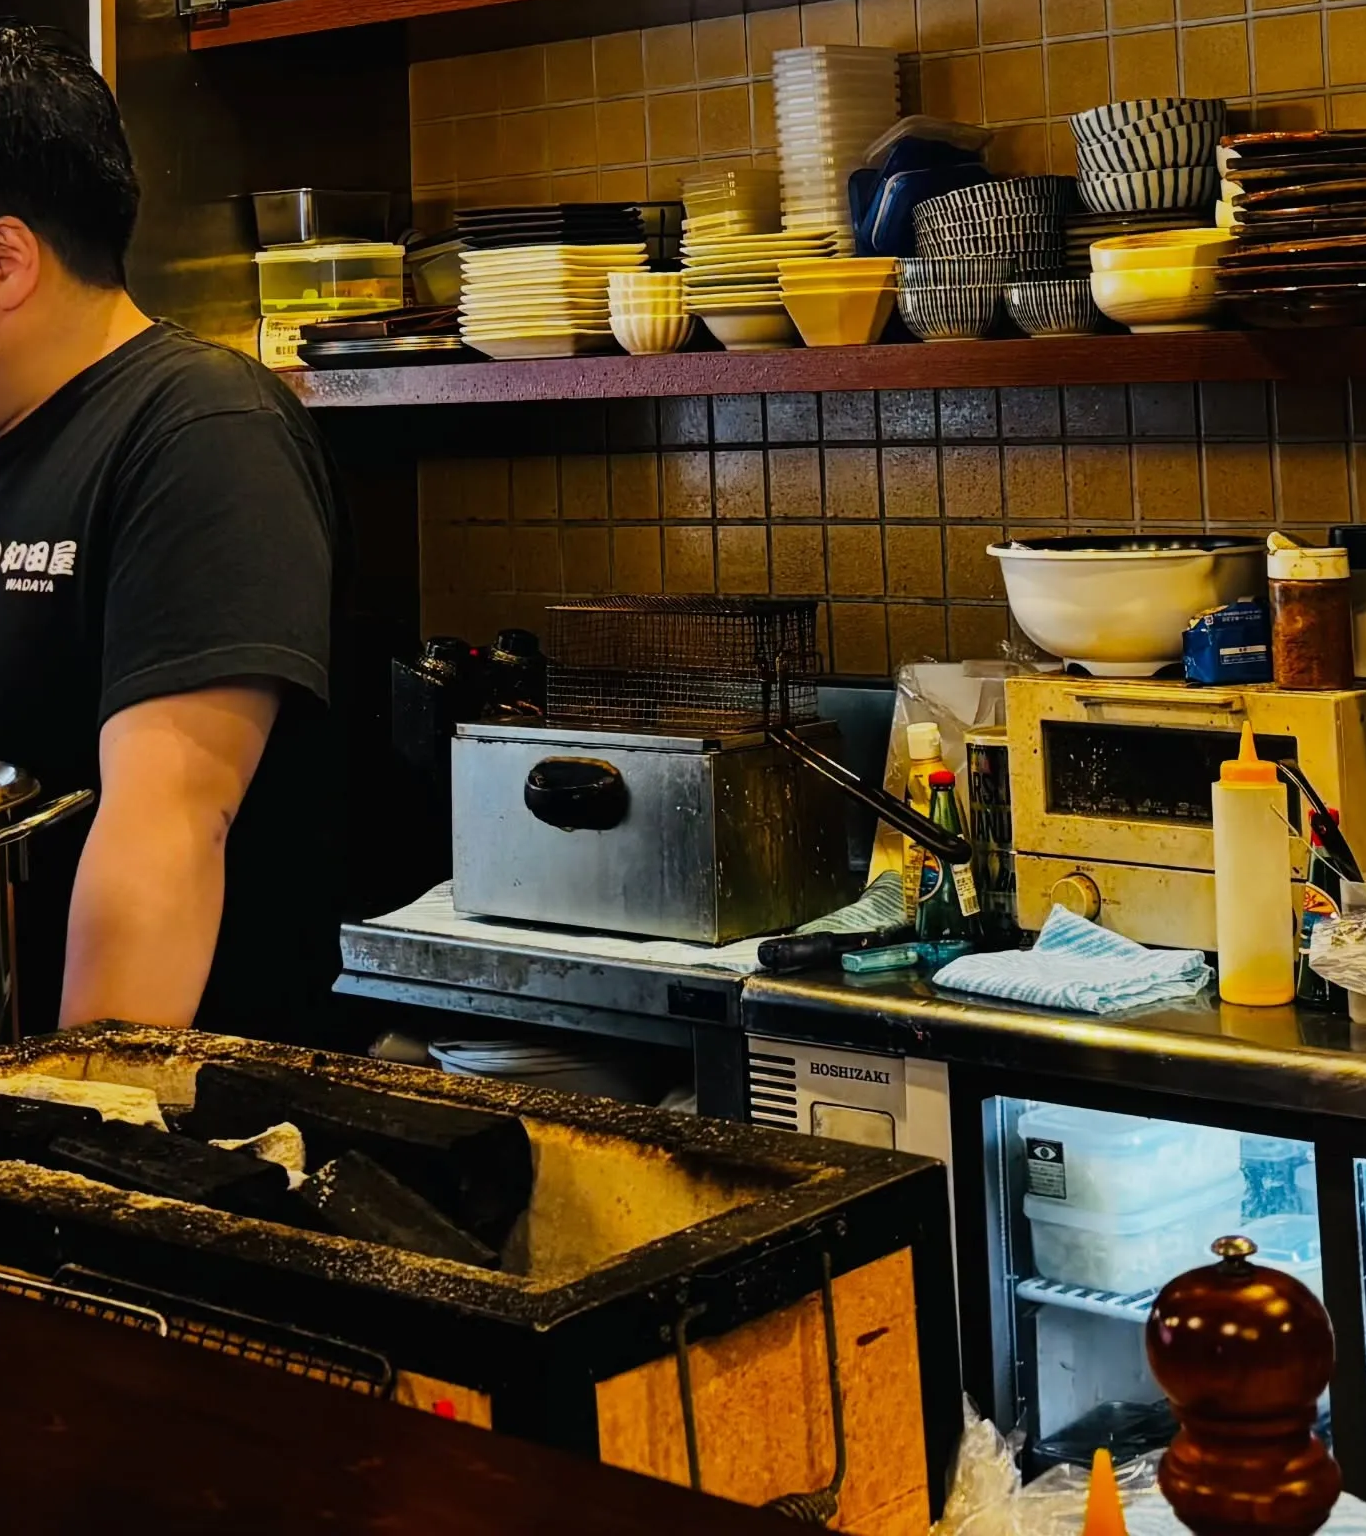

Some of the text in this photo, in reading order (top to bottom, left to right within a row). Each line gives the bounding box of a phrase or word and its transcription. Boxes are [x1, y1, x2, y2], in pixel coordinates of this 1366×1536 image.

[0, 540, 78, 577] 和田屋
[4, 577, 55, 593] WADAYA
[809, 1061, 892, 1086] HOSHIZAKI
